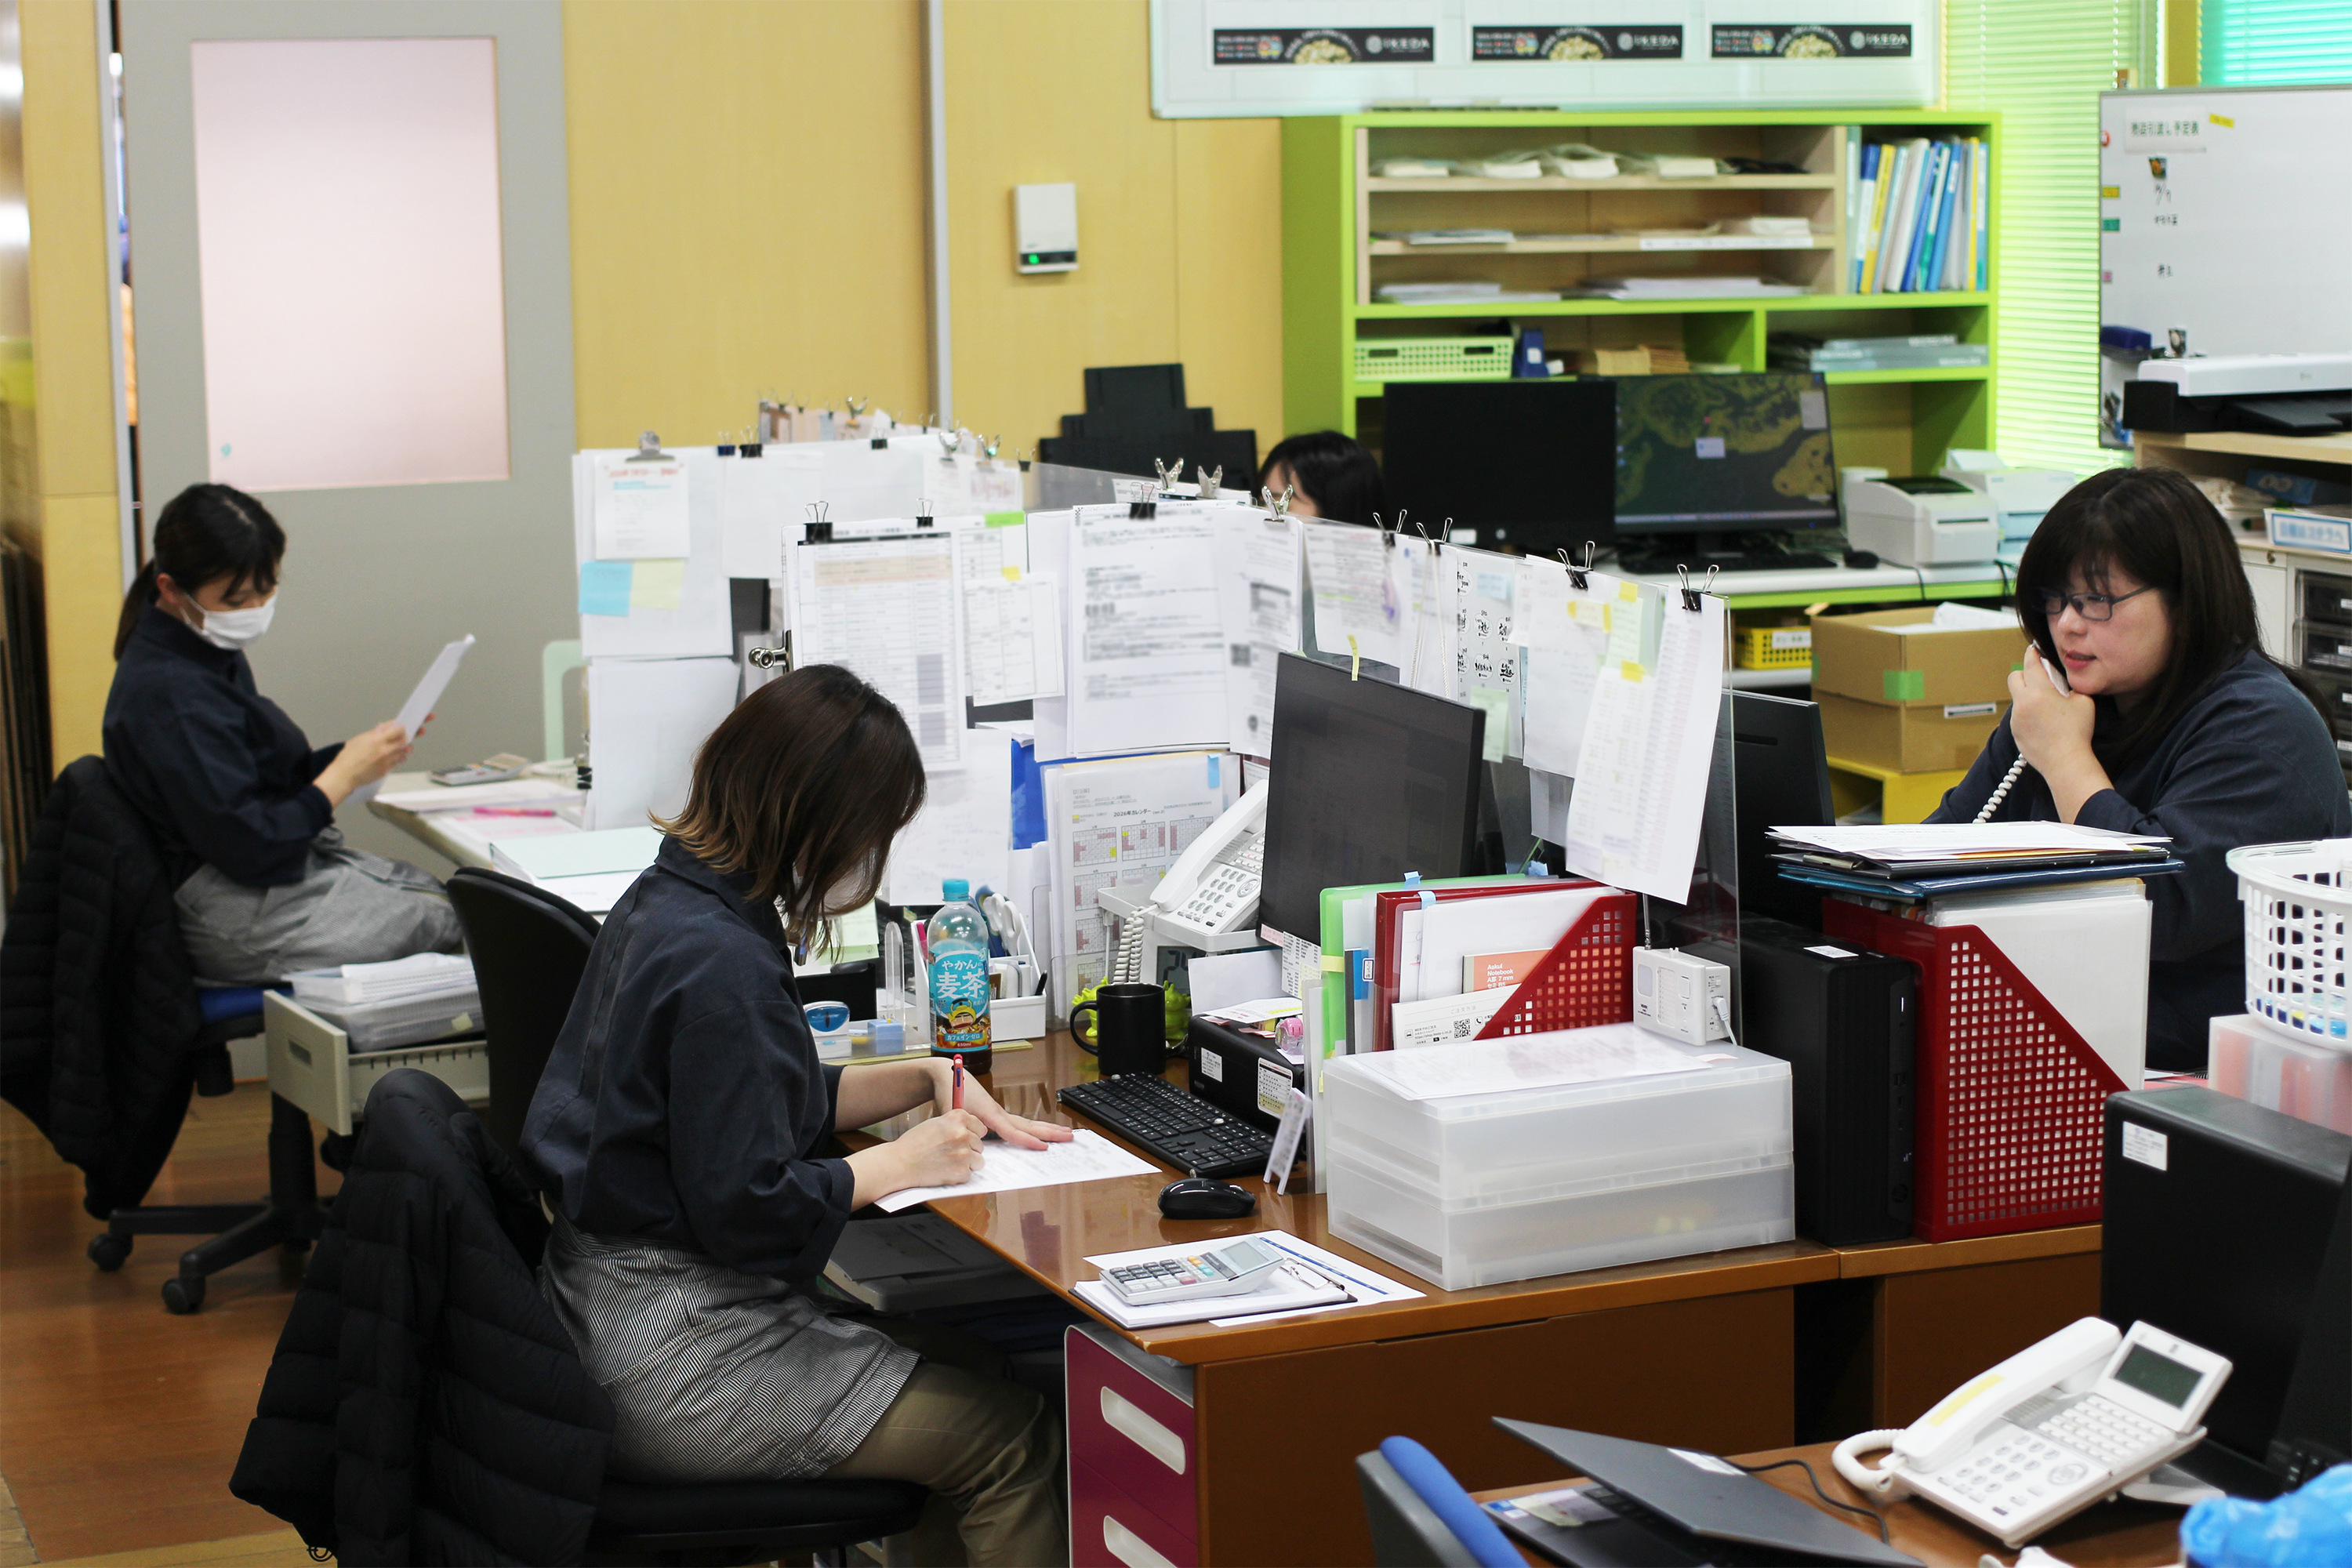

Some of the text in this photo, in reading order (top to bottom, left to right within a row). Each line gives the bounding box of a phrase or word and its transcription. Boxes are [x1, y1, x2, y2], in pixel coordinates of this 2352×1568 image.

[1113, 808, 1151, 817] 2026年カレンダー
[942, 960, 983, 971] やかんの
[936, 968, 986, 999] 麦茶
[1450, 1005, 1476, 1014] ご注文方法
